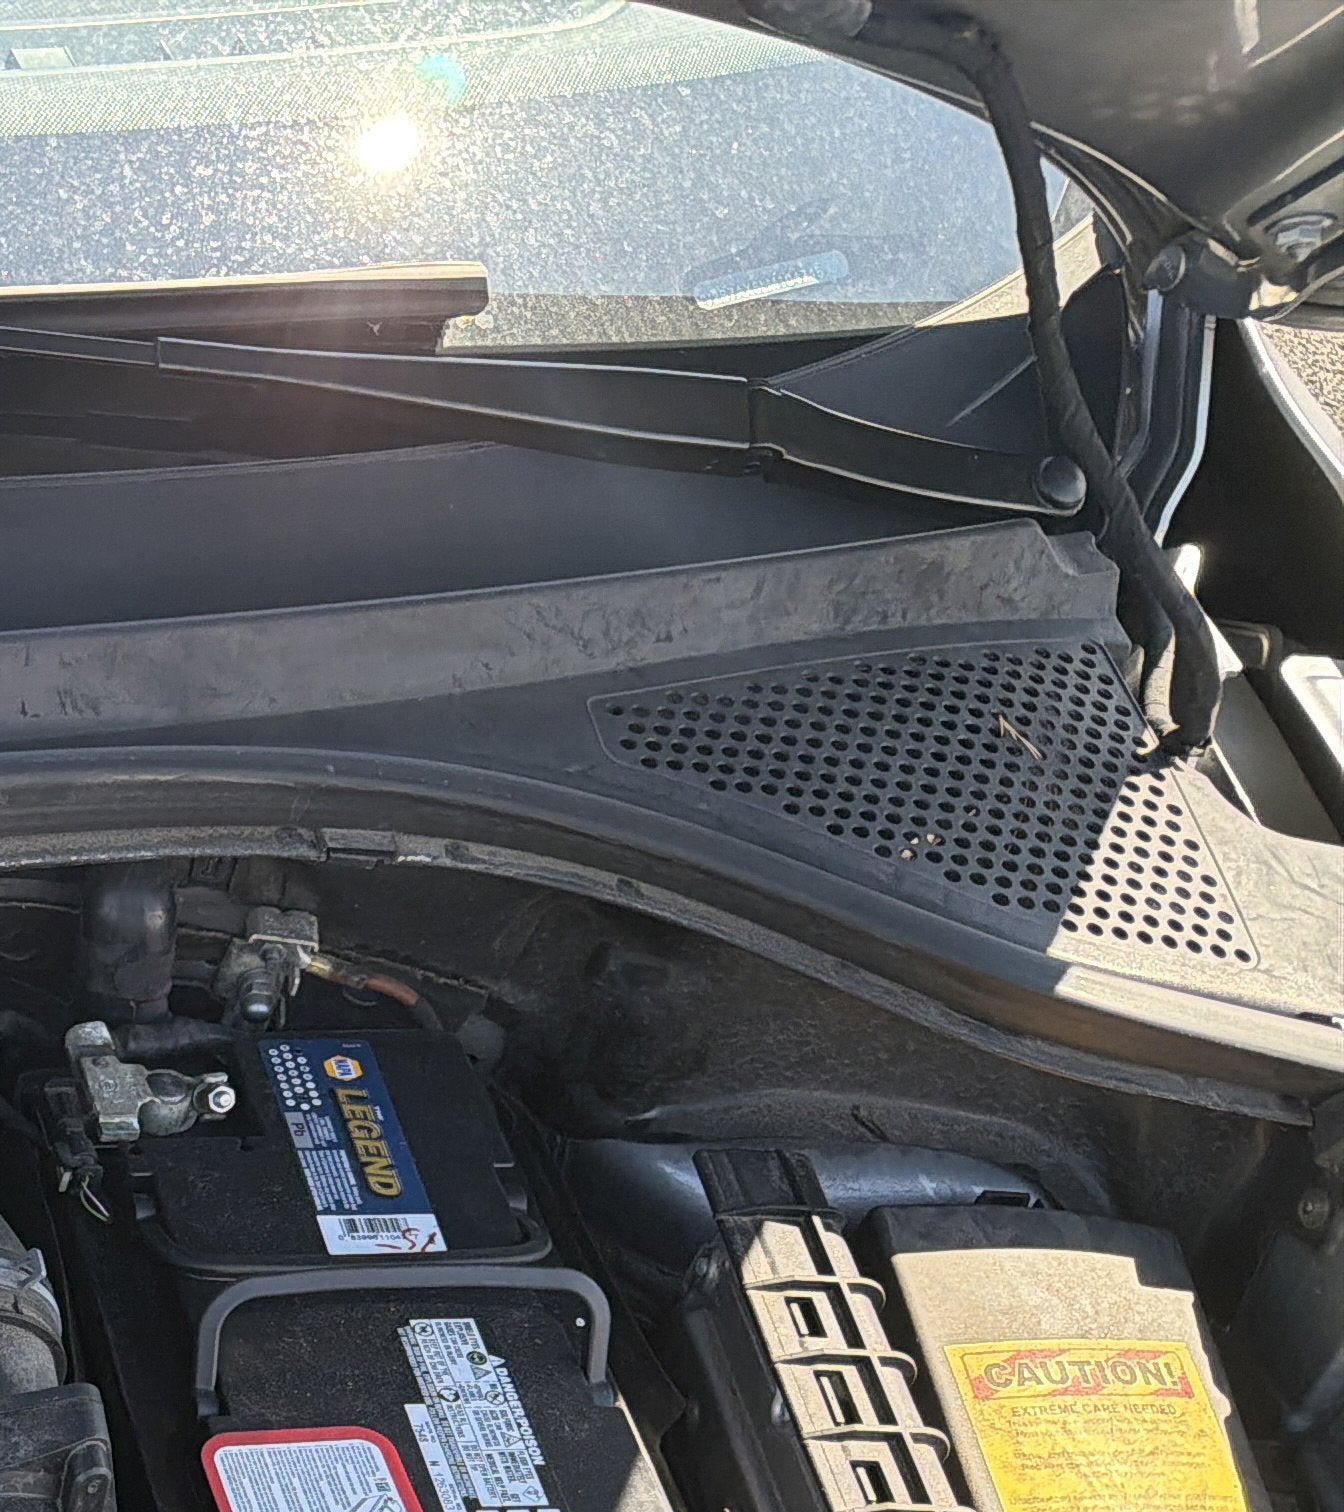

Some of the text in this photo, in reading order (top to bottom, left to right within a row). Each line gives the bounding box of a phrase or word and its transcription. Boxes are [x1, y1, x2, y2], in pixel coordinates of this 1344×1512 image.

[331, 1058, 355, 1077] NAPA
[291, 1122, 305, 1137] Pb
[333, 1086, 403, 1197] LEGEND
[983, 1359, 1179, 1388] CAUTION!
[494, 1367, 546, 1465] DANGER/POISON
[1011, 1403, 1178, 1418] EXTREME CARE NEEDED
